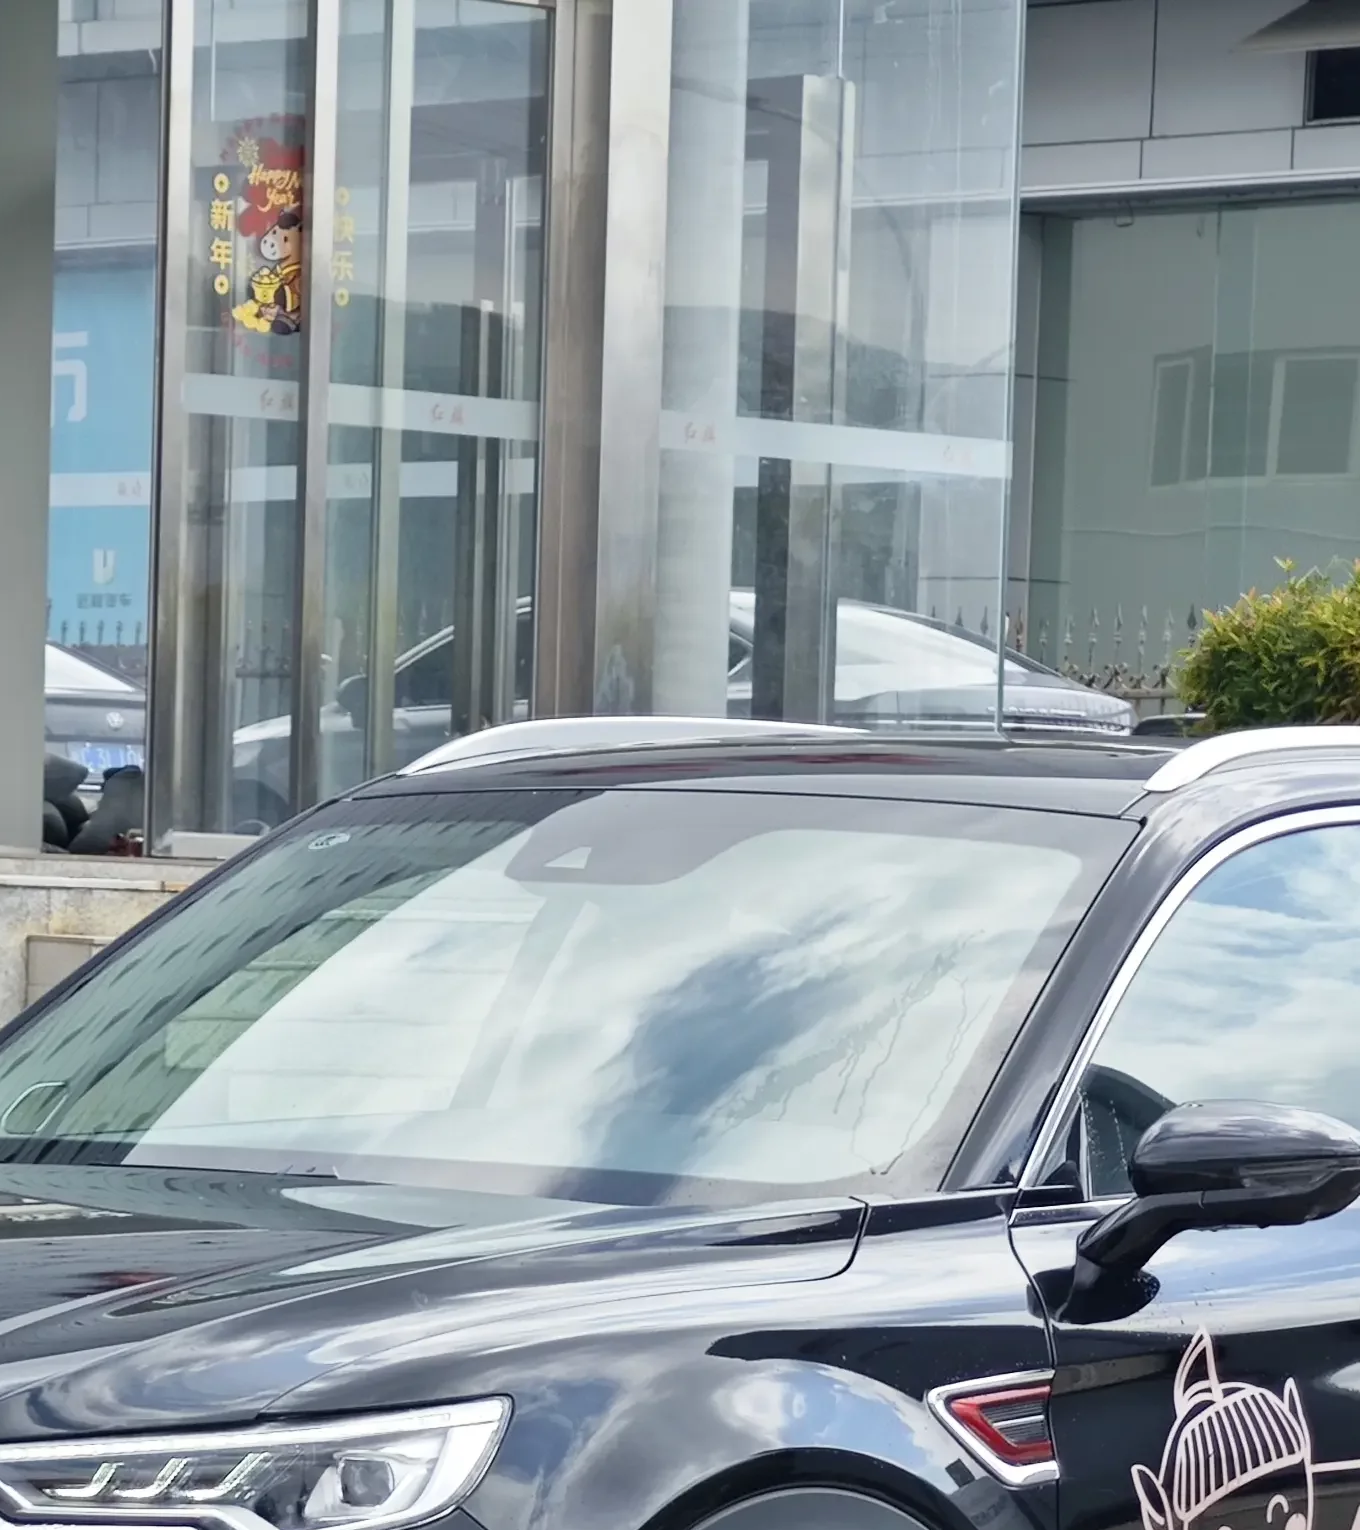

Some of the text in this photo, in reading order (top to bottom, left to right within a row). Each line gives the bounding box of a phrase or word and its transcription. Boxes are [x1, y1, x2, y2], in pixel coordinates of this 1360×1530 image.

[248, 163, 291, 190] Happy
[257, 187, 300, 212] Year
[209, 199, 234, 269] 新年
